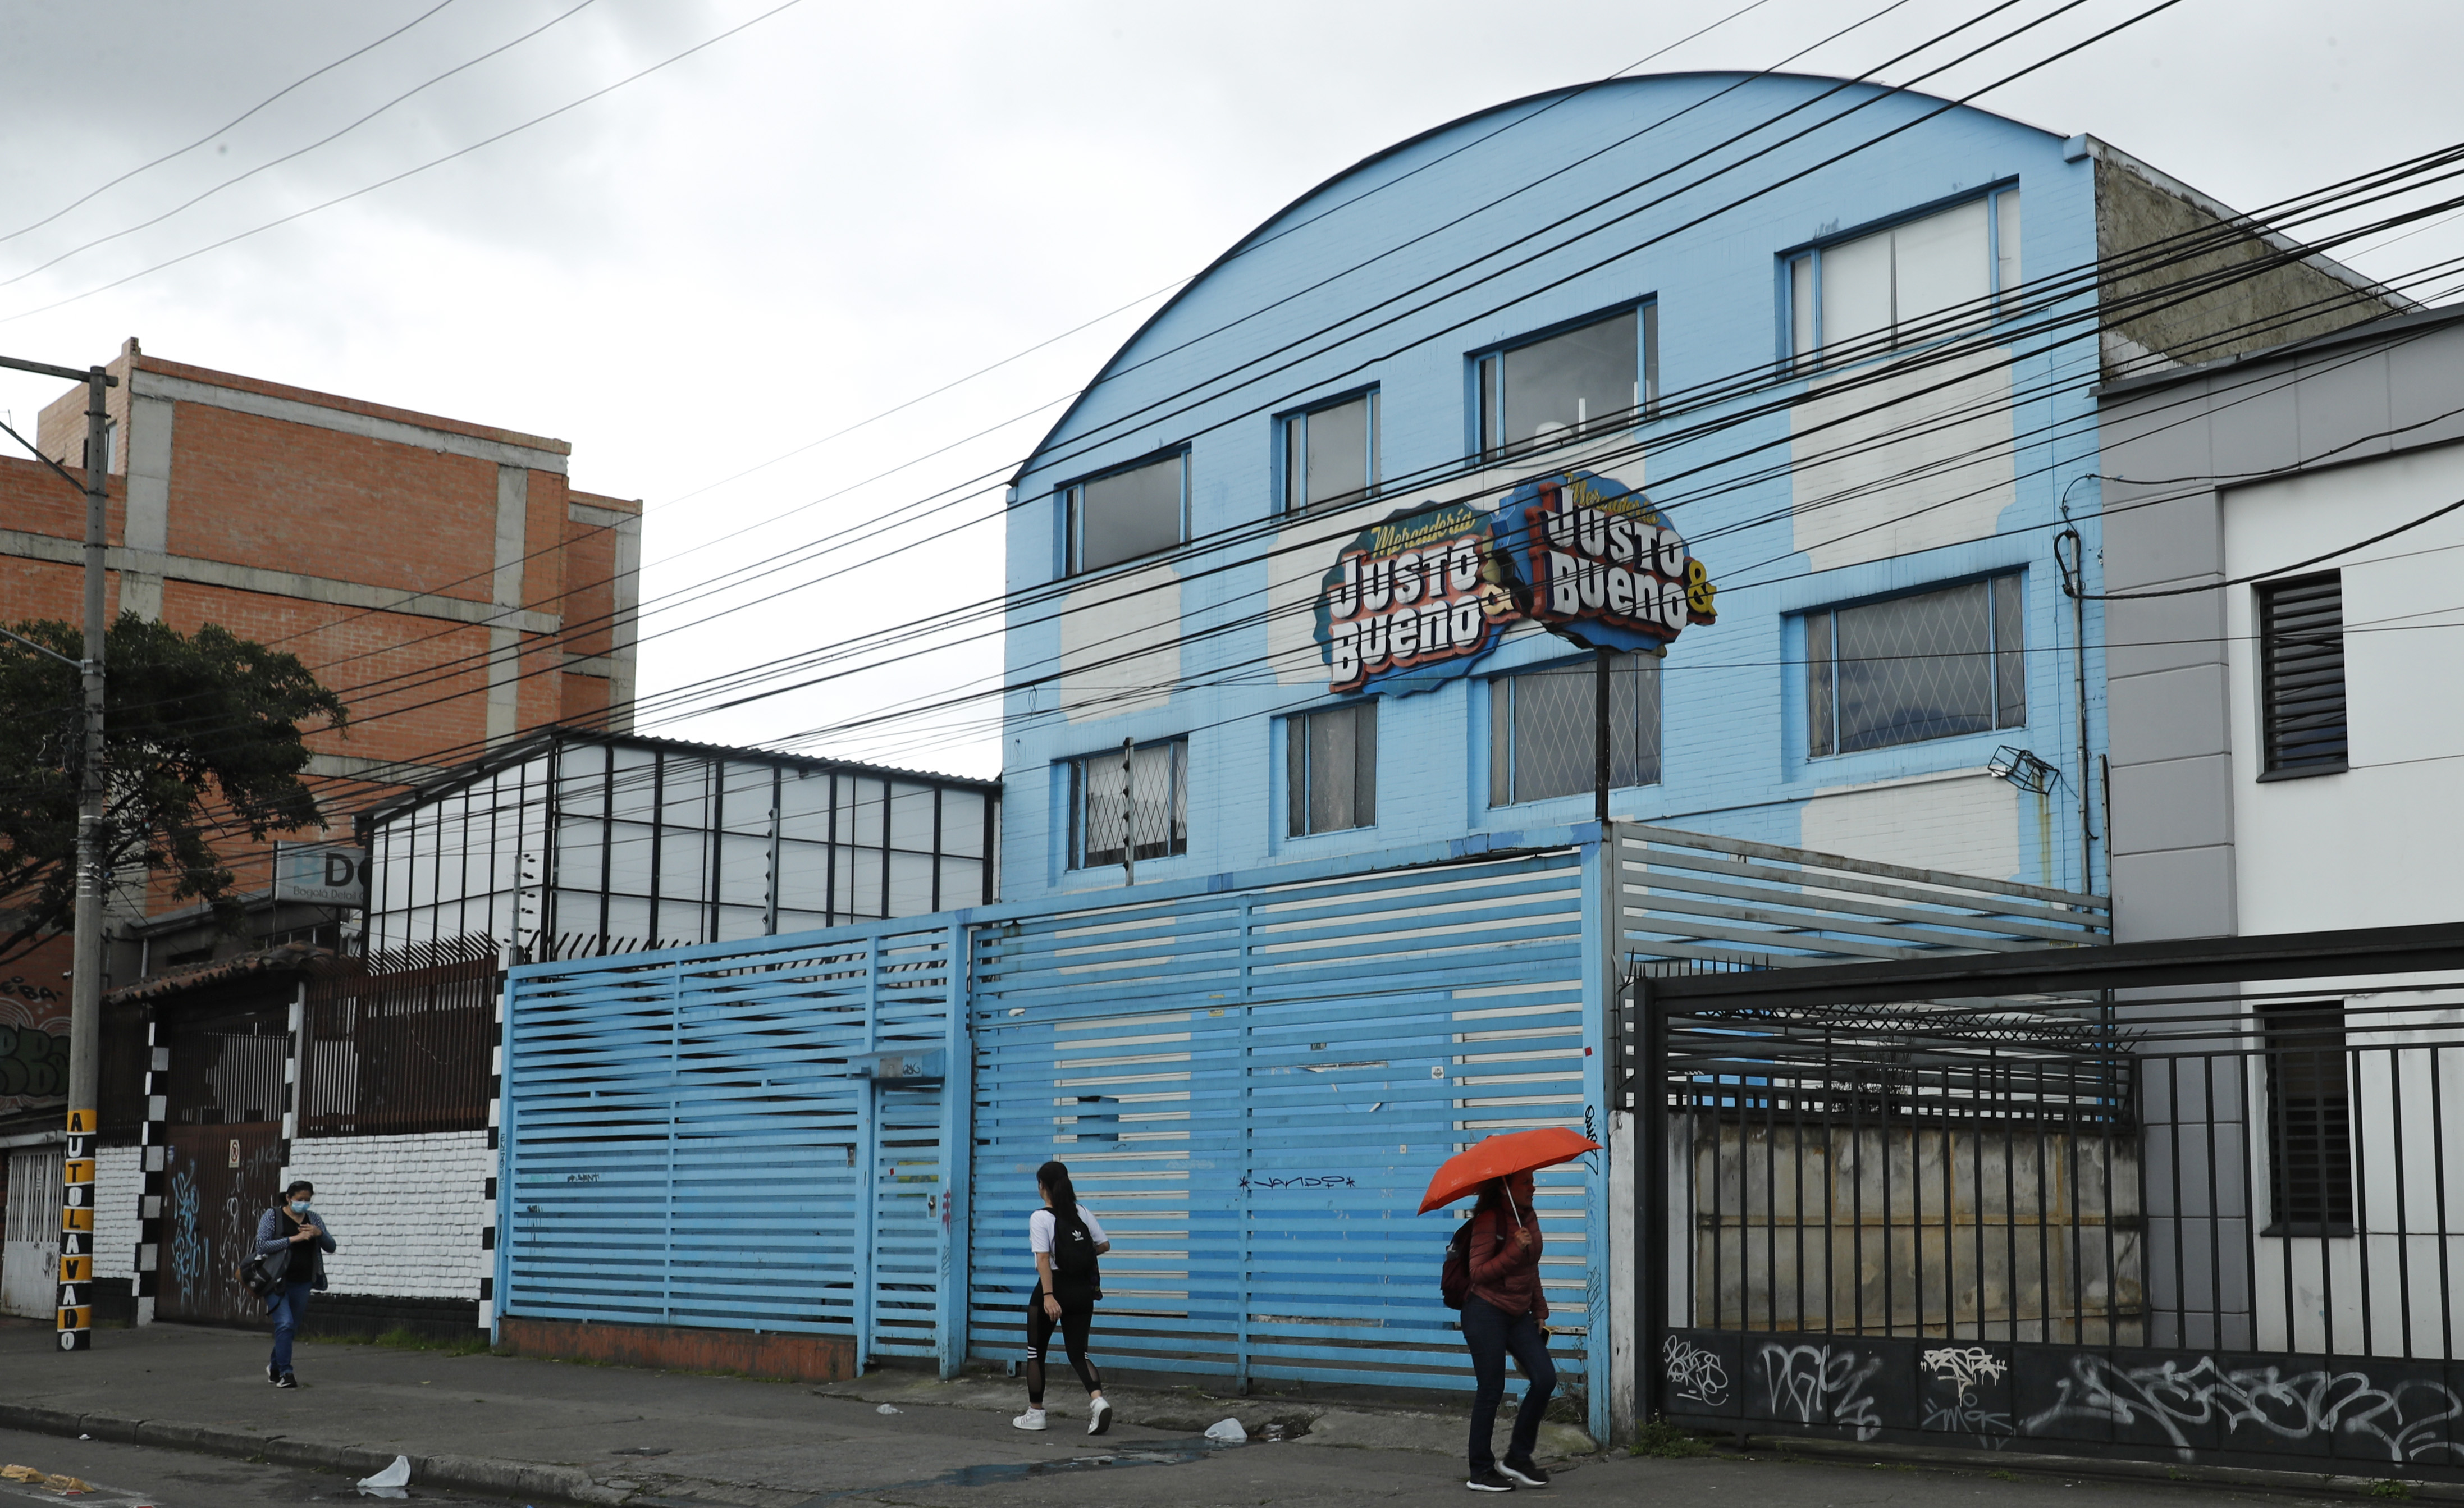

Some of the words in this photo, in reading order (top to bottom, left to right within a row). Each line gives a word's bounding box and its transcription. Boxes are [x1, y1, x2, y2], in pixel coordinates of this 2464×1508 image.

[1371, 508, 1476, 559] Mercadería
[1687, 561, 1717, 615] &
[294, 849, 364, 887] BD
[294, 885, 328, 898] Bogotá
[331, 889, 356, 901] Detail
[61, 1112, 83, 1350] AUTOLAVADO
